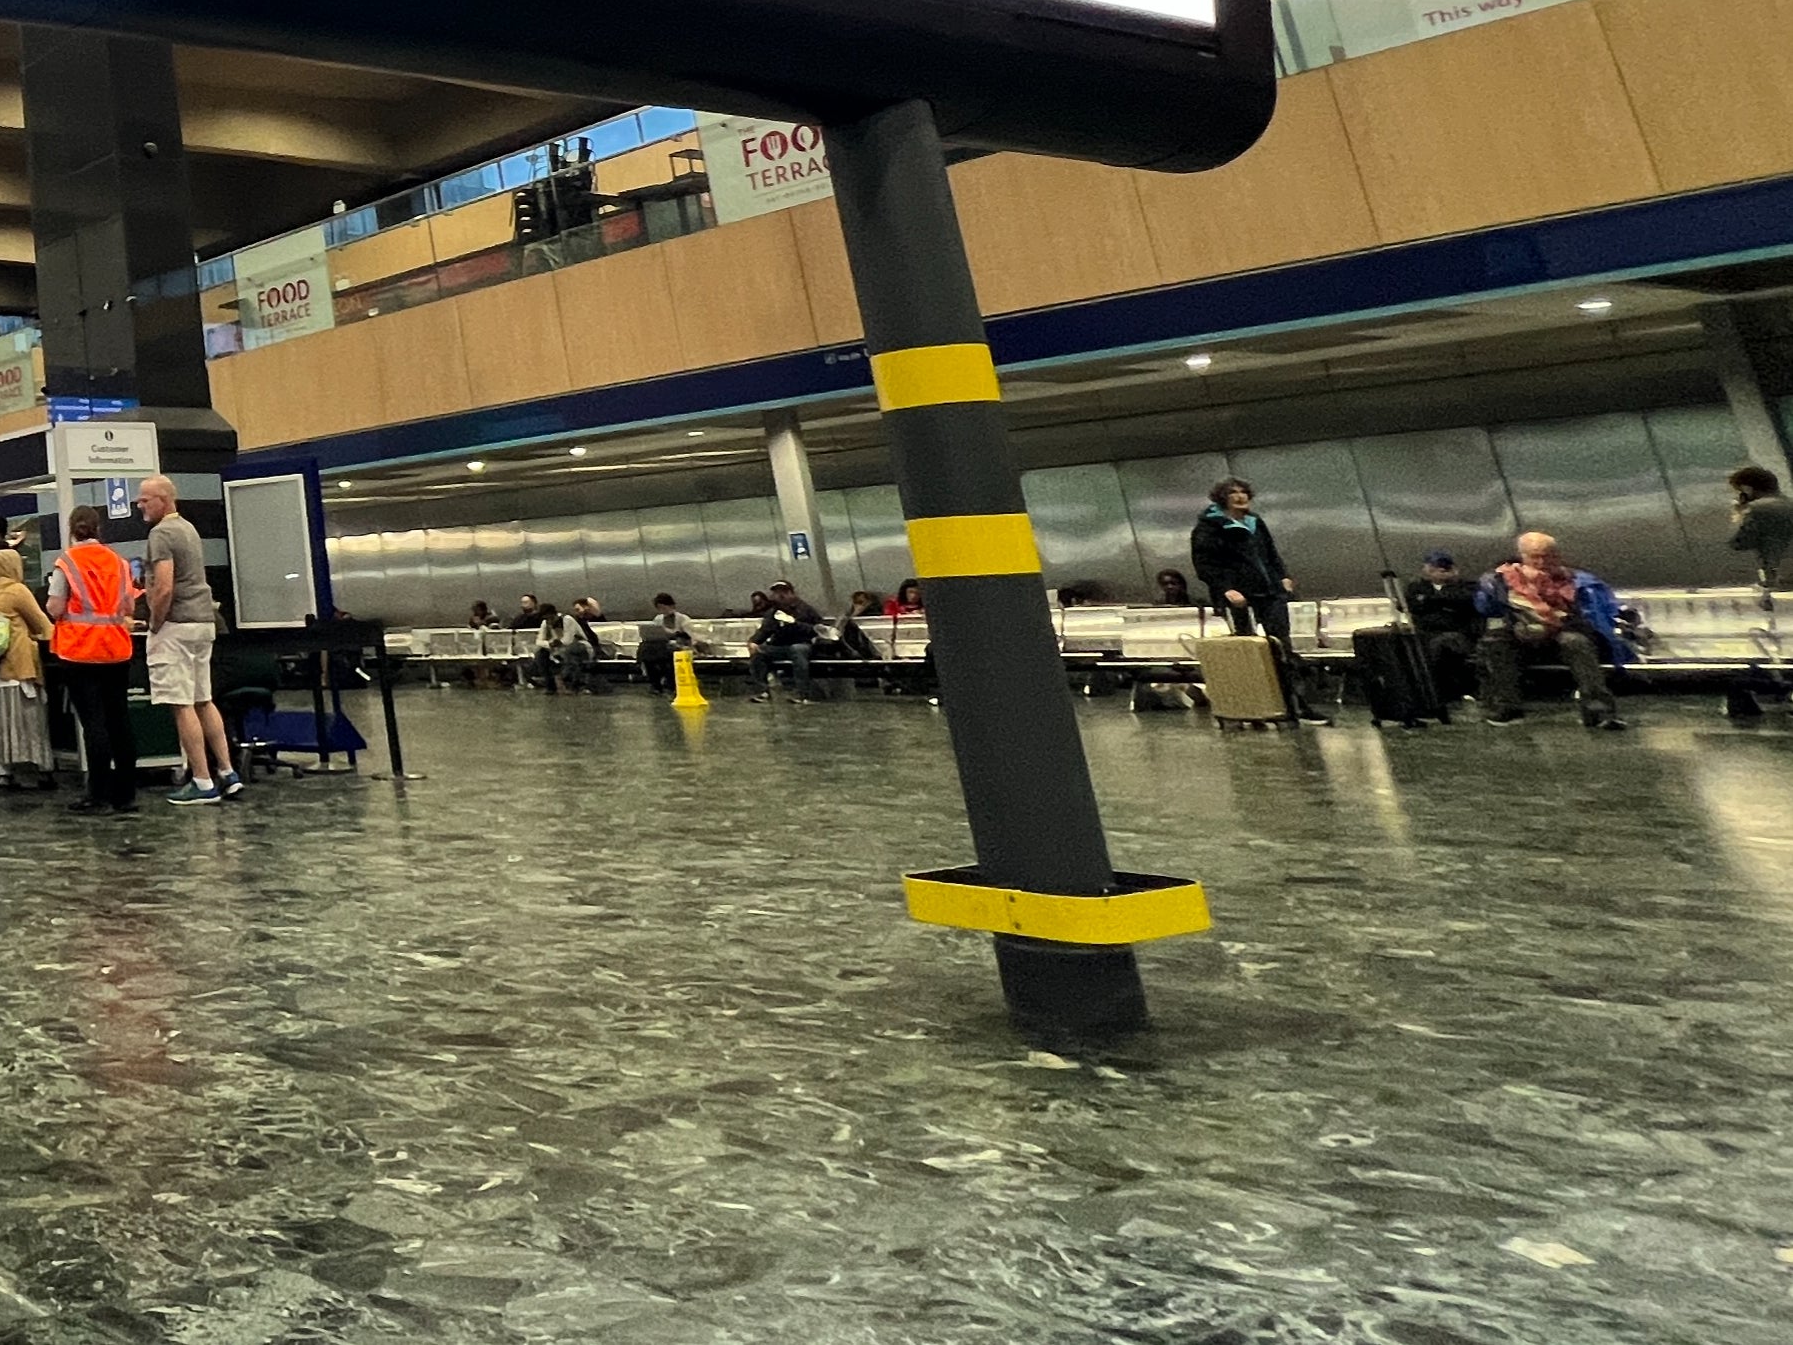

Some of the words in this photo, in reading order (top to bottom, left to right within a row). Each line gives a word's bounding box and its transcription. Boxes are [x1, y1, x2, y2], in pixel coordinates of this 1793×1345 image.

[1423, 6, 1472, 26] This
[741, 124, 822, 168] FOO
[746, 156, 830, 191] TERRAC
[258, 279, 310, 313] FOOD
[260, 303, 312, 328] TERRACE
